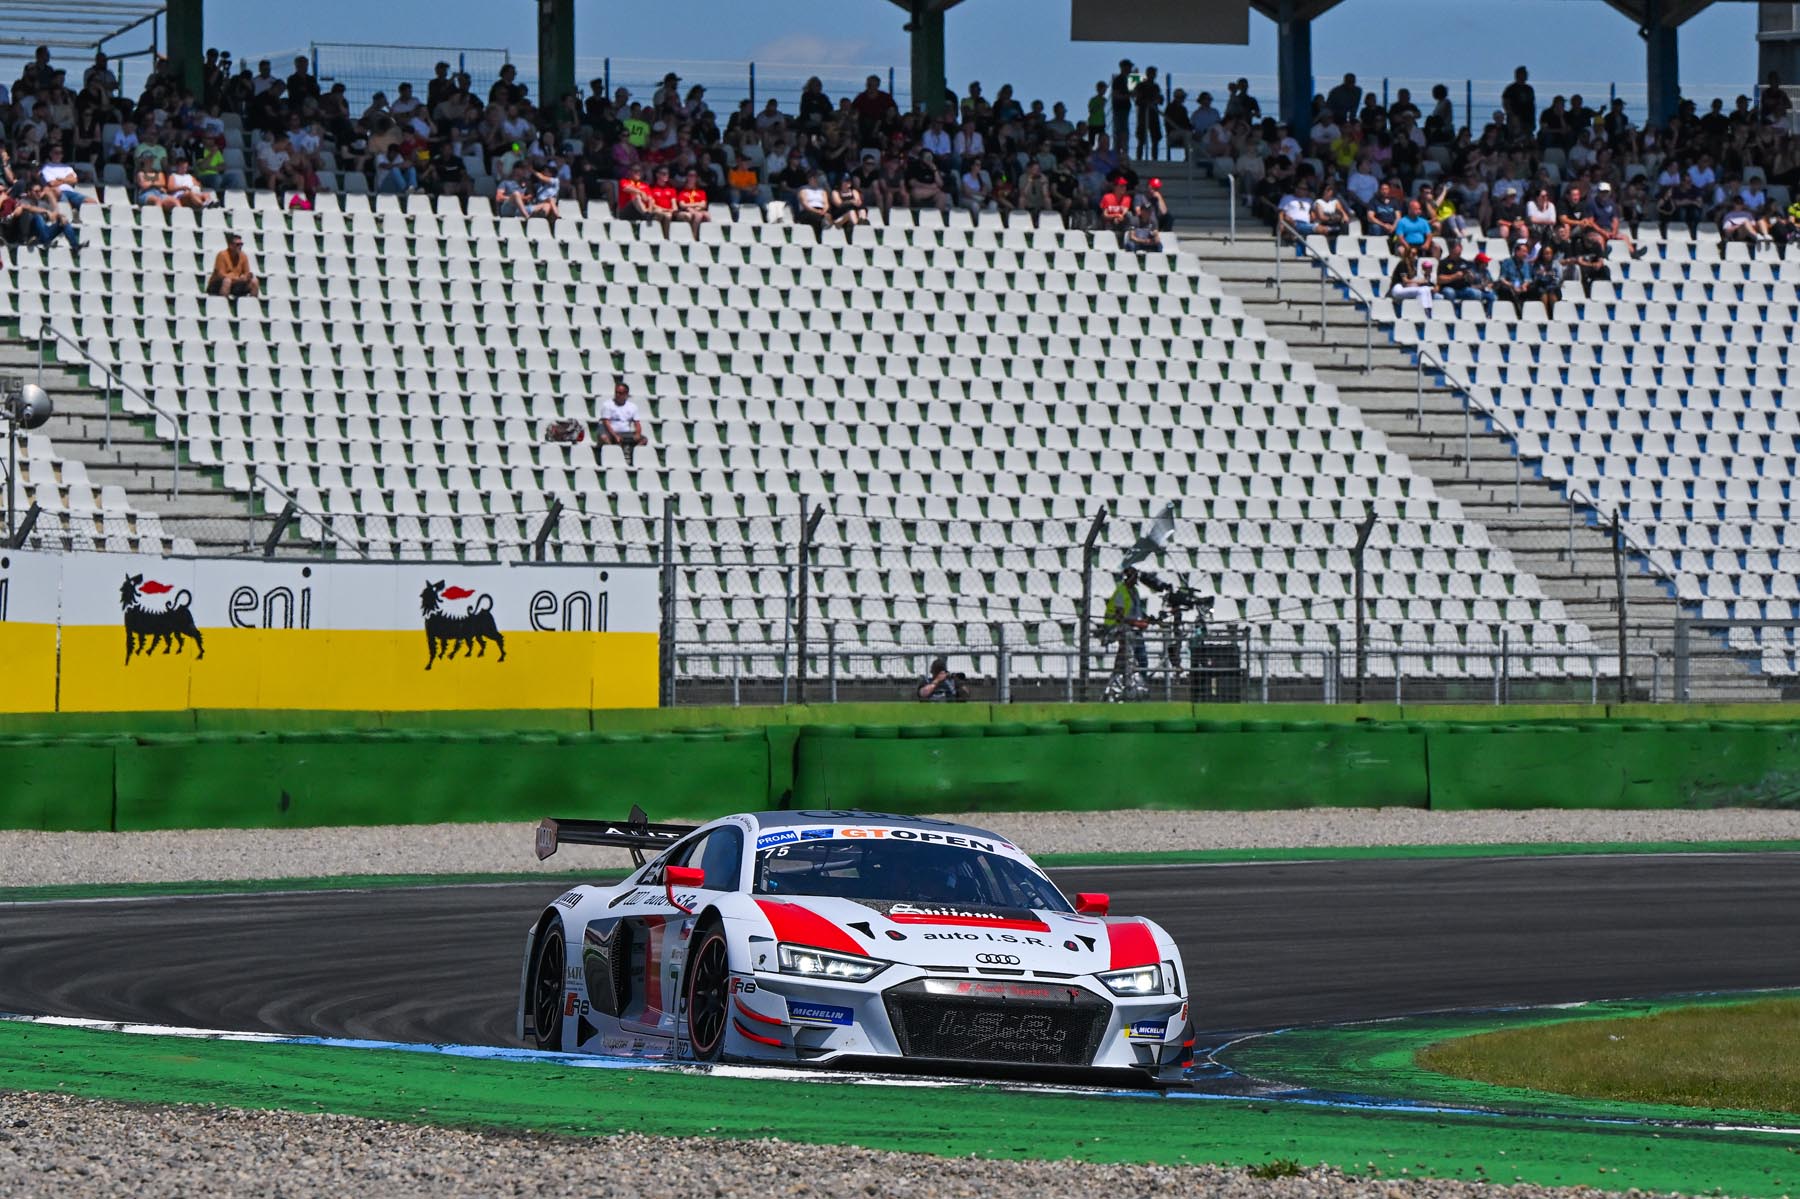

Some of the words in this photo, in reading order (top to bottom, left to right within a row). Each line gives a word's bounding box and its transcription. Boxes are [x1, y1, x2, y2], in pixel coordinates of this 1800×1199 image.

[229, 566, 311, 629] eni
[529, 571, 609, 632] eni
[758, 832, 796, 846] PROAM
[764, 846, 791, 859] 75
[924, 931, 979, 941] auto
[792, 1007, 844, 1020] MICHELIN
